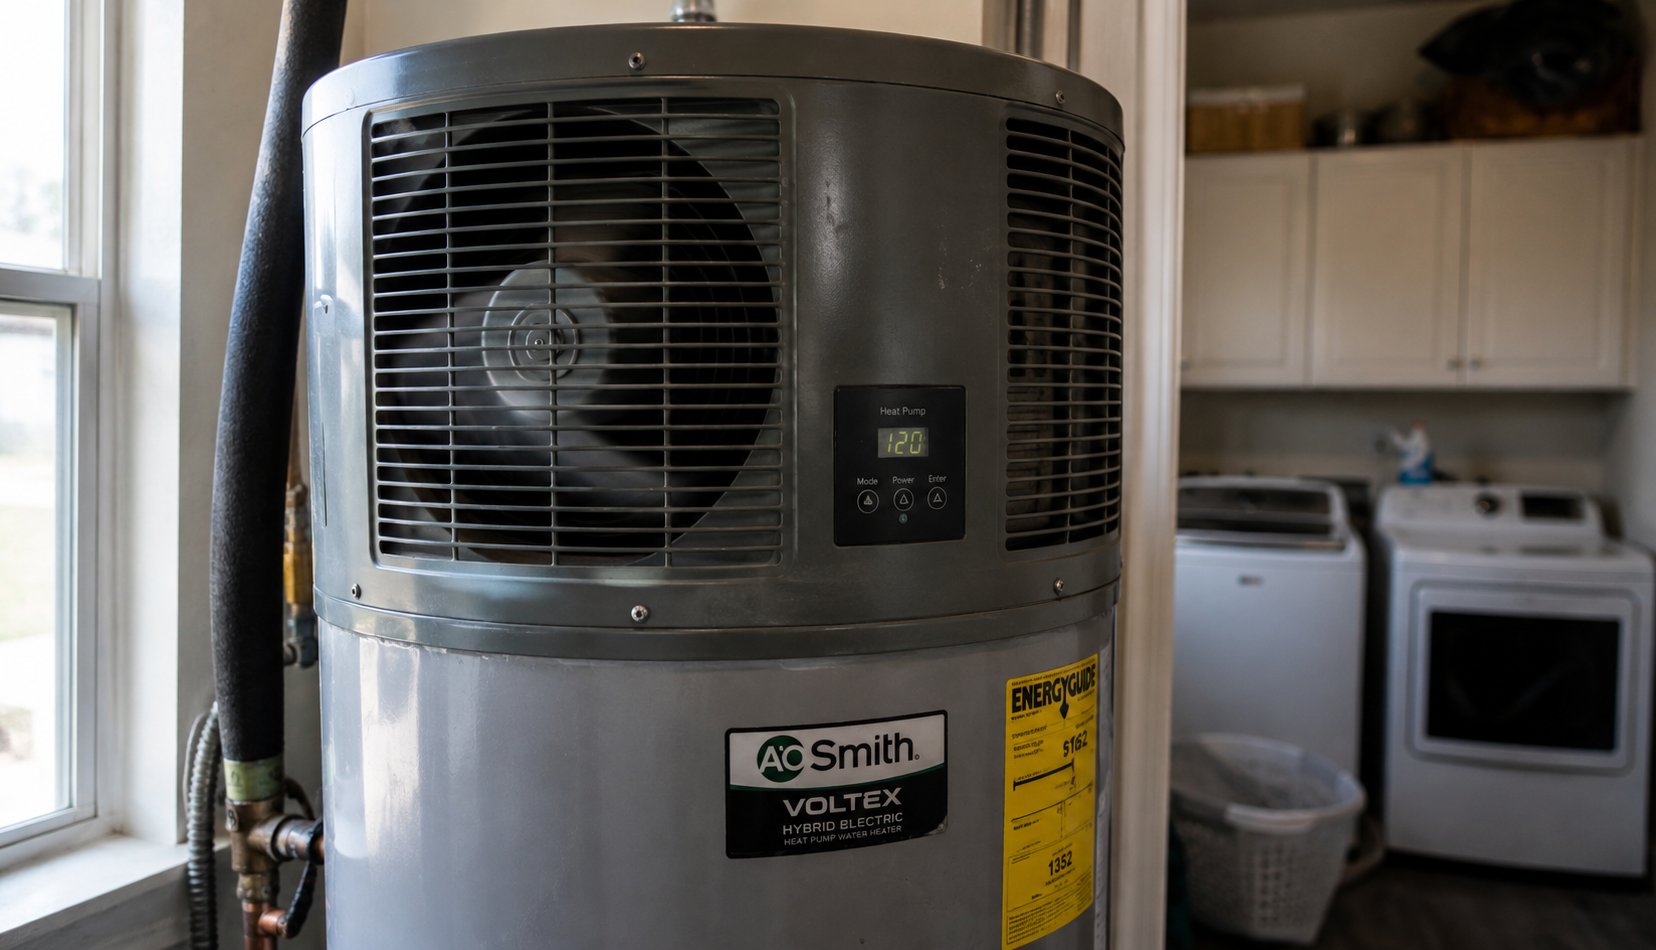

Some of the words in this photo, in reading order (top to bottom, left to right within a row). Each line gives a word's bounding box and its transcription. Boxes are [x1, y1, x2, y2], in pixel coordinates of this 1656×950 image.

[880, 406, 900, 416] Heat
[902, 406, 926, 417] Pump
[888, 431, 922, 454] 120
[857, 477, 878, 486] Mode
[892, 476, 915, 484] Power
[928, 474, 947, 483] Enter
[1011, 663, 1096, 714] ENERGYGUIDE
[810, 732, 914, 771] Smith
[782, 787, 902, 817] VOLTEX
[783, 820, 836, 835] HYBRID
[784, 836, 808, 846] HEAT
[811, 833, 836, 844] PUMP
[838, 829, 868, 841] WATER
[869, 824, 902, 836] HEATER
[1048, 850, 1072, 876] 1352
